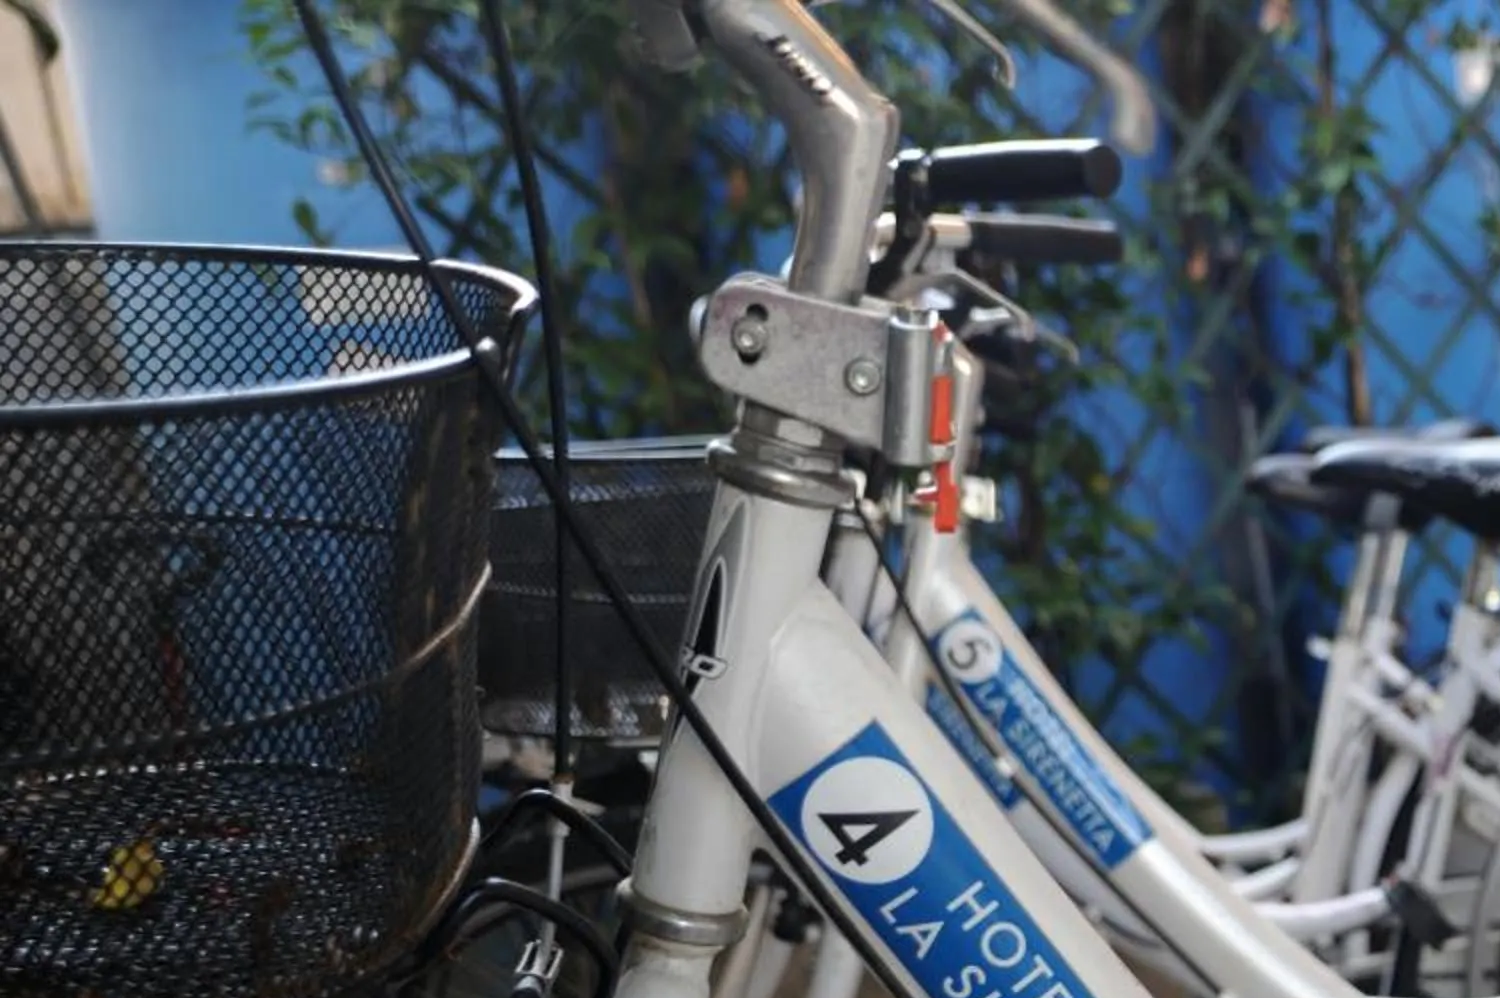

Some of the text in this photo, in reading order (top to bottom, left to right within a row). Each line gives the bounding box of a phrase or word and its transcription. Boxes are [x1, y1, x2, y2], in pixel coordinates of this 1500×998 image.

[948, 637, 994, 671] 5
[977, 680, 1115, 853] LA SIRENETTA
[817, 809, 921, 867] 4
[879, 887, 945, 960] LA
